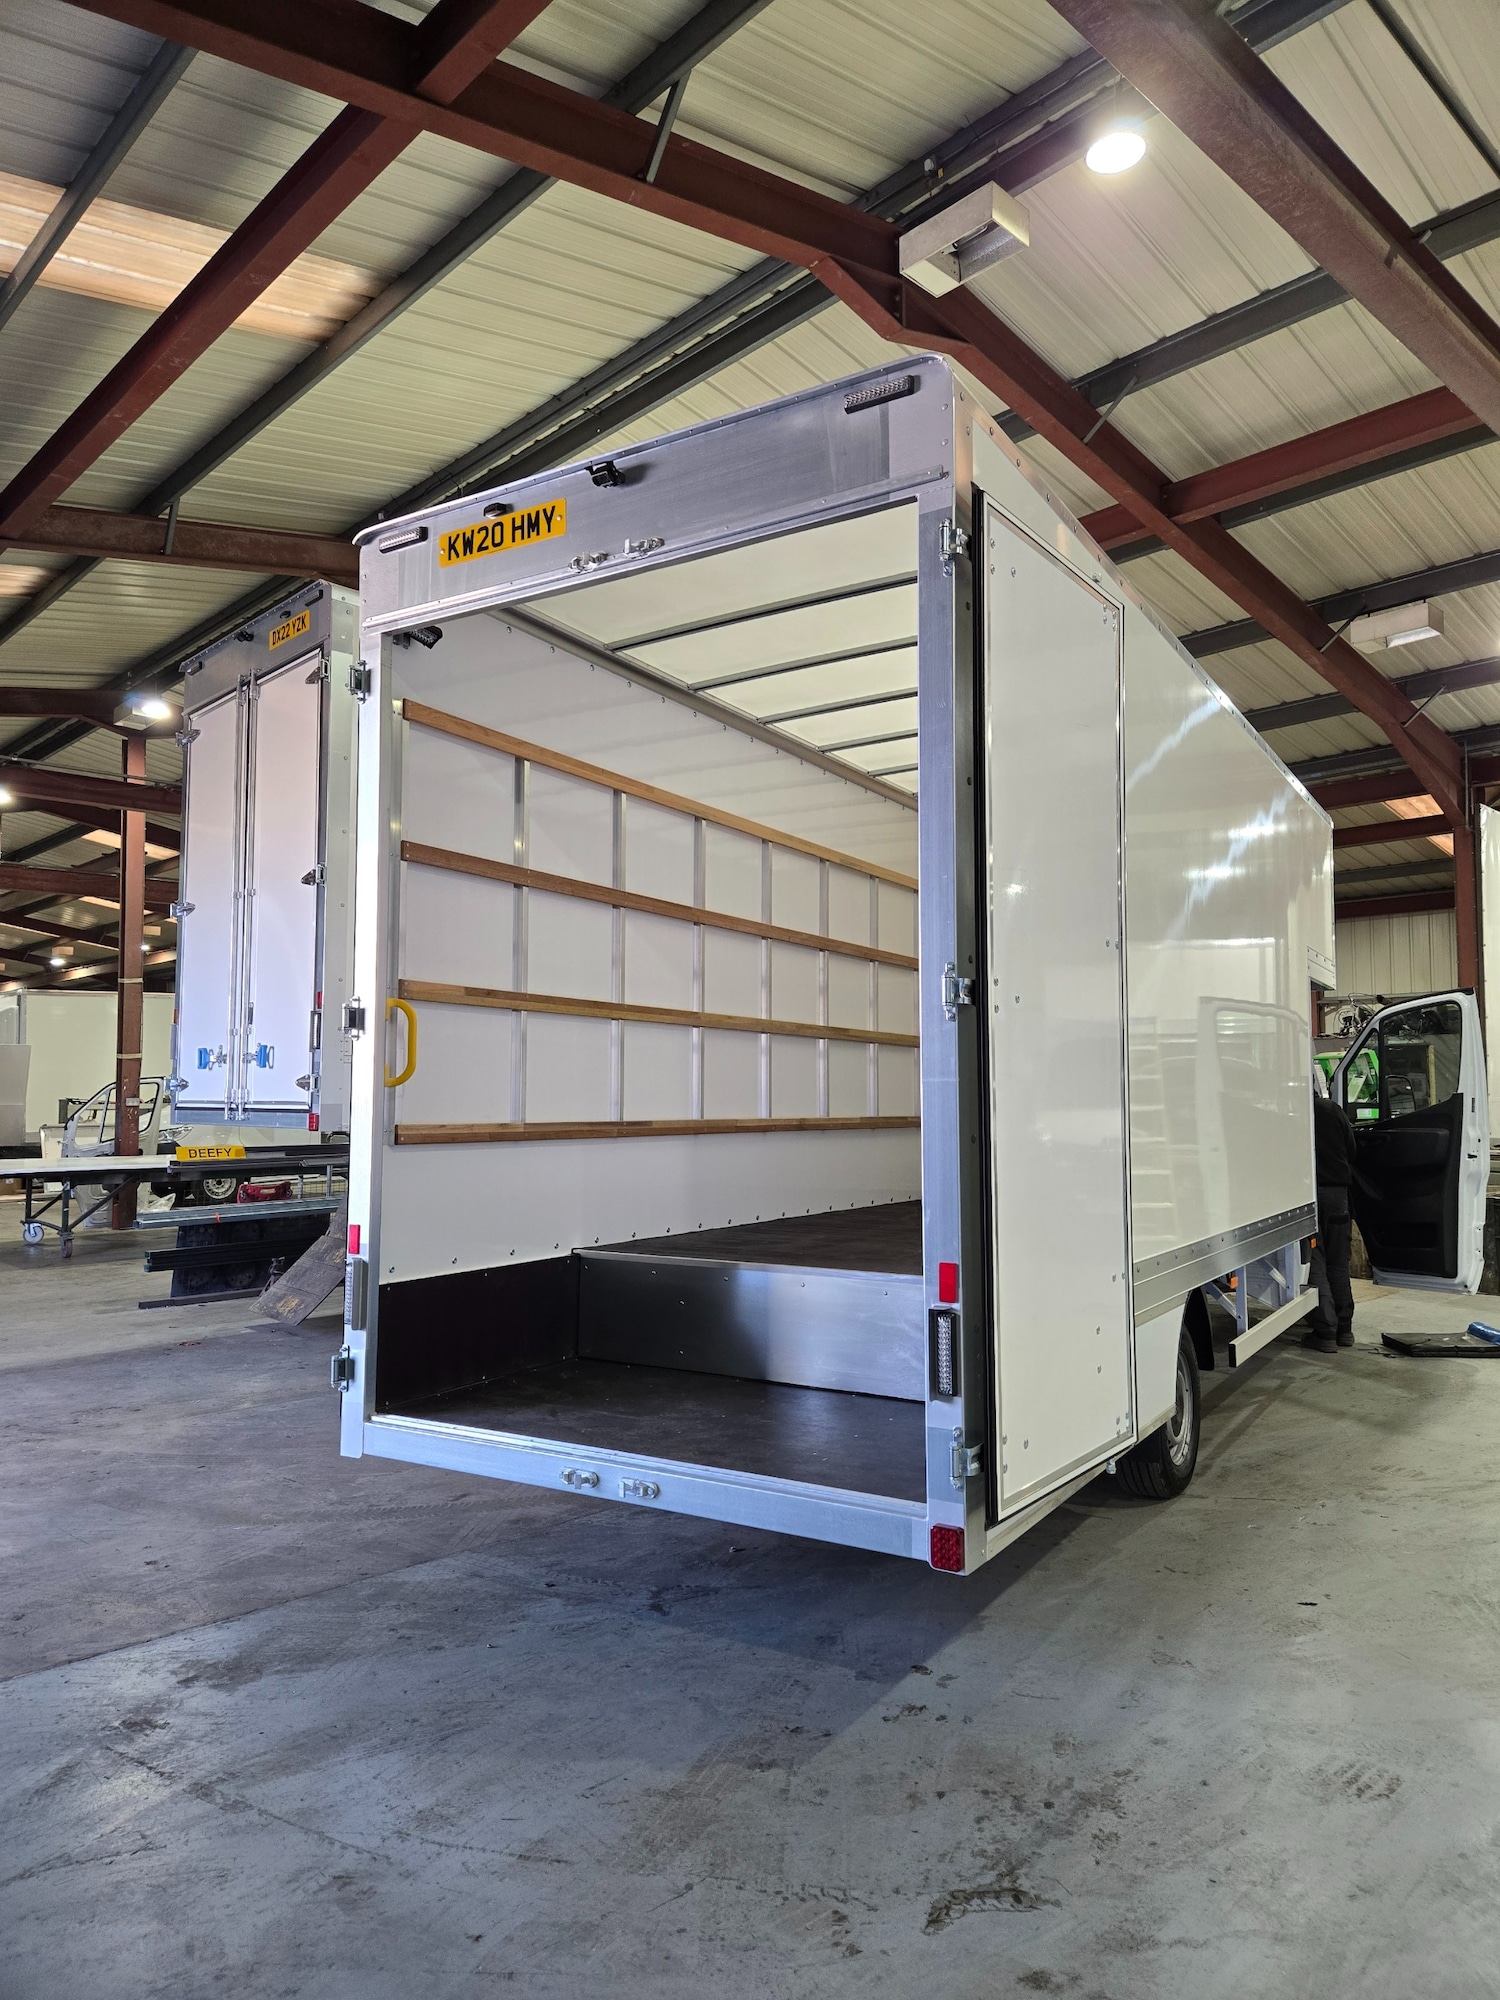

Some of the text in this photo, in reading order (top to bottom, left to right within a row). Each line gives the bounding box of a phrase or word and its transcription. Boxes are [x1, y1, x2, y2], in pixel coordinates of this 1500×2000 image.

[447, 505, 556, 561] KW20 HMY
[272, 614, 307, 646] DX22 YZK
[188, 1148, 232, 1159] DEEFY
